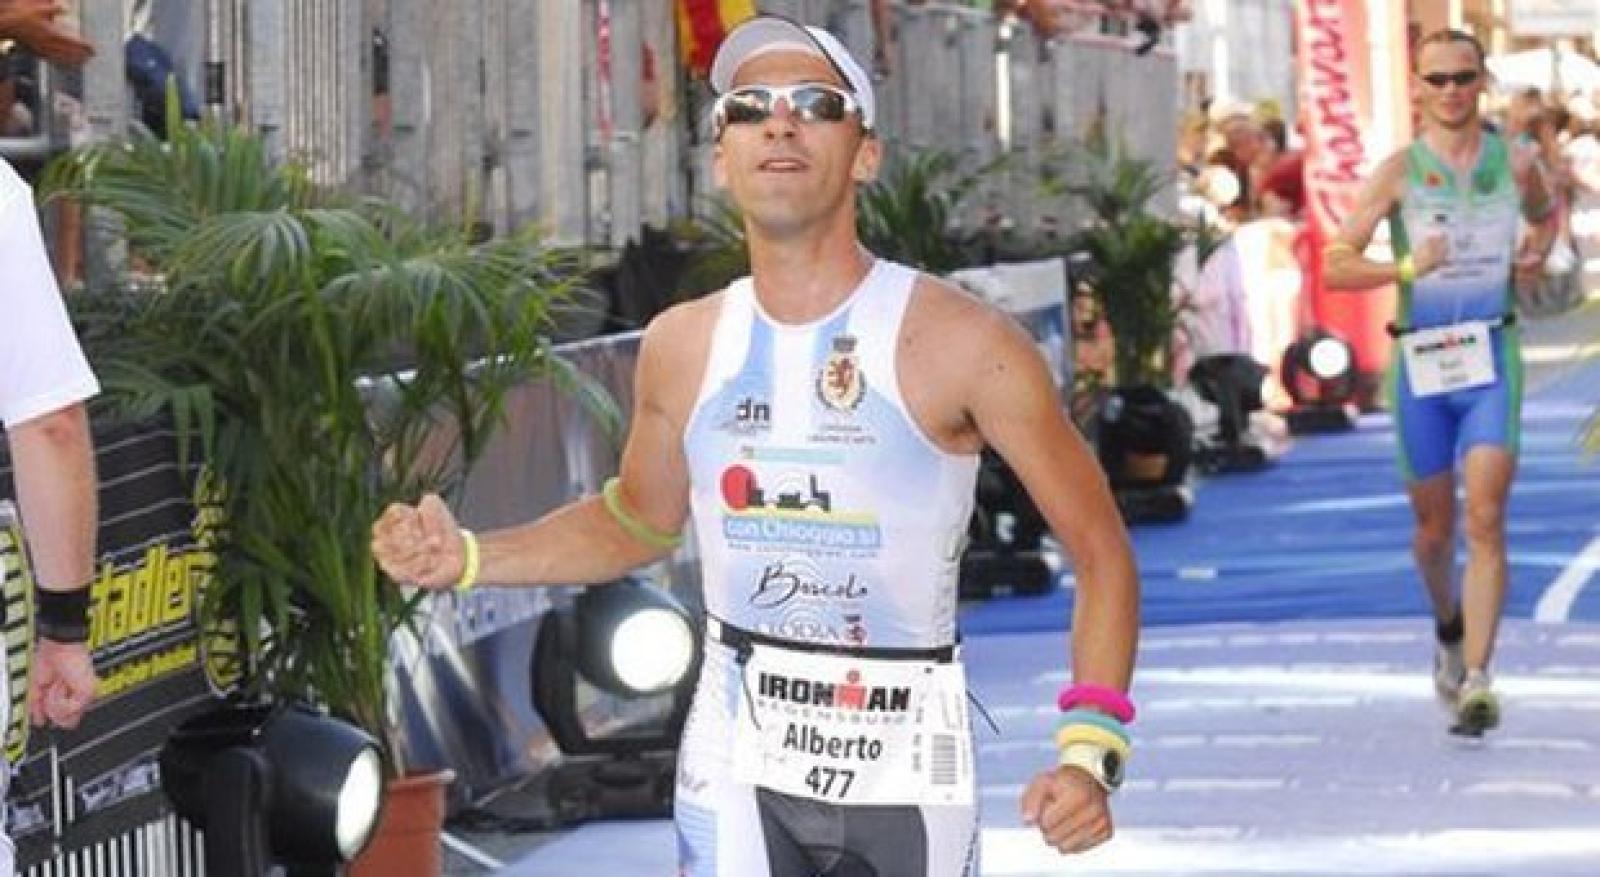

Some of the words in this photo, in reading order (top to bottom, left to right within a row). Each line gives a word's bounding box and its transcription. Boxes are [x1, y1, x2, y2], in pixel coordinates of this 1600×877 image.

[86, 543, 218, 650] tadler
[757, 669, 911, 712] IRONMAN
[783, 722, 883, 762] Alberto
[804, 765, 855, 798] 477
